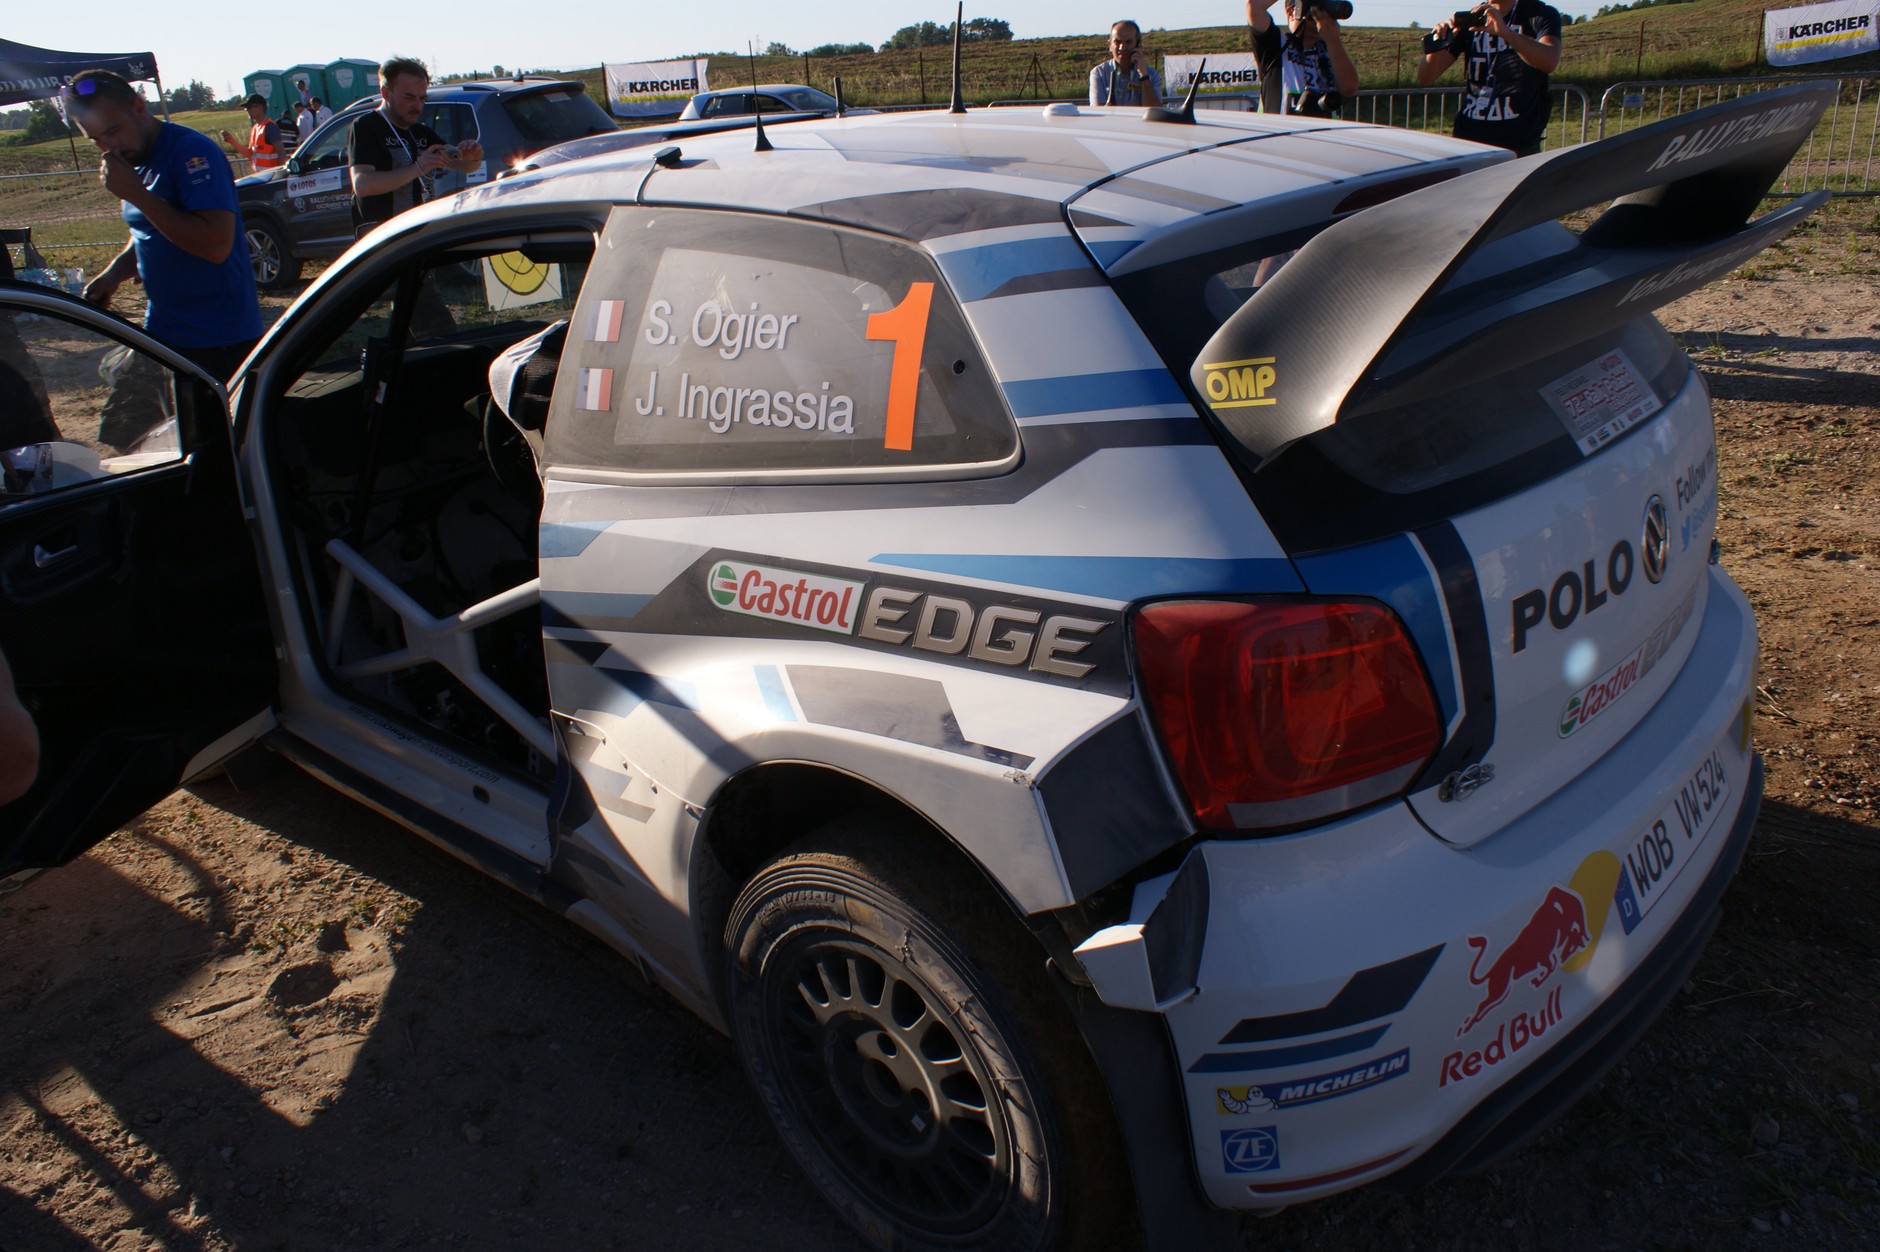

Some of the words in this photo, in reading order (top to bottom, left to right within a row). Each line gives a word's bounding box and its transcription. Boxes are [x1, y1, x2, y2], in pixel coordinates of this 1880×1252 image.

[1788, 14, 1870, 40] KÄRCHER
[628, 78, 699, 93] KÄRCHER
[297, 179, 317, 190] LOTOS
[645, 300, 677, 346] S.
[692, 300, 798, 360] Ogier
[864, 282, 935, 451] 1
[1206, 365, 1276, 401] OMP
[635, 371, 664, 416] J.
[678, 372, 855, 434] Ingrassia
[1676, 459, 1706, 512] Follow
[738, 569, 854, 629] Castrol
[858, 586, 1116, 680] EDGE
[1512, 539, 1634, 655] POLO
[1578, 646, 1643, 725] Castrol
[1627, 819, 1674, 898] WOB
[1674, 780, 1703, 839] VW
[1695, 751, 1726, 812] 524
[1622, 898, 1633, 918] D
[1439, 1023, 1506, 1088] Red
[1510, 984, 1563, 1053] Bull
[1279, 1054, 1409, 1101] MICHELIN
[1229, 1136, 1271, 1164] ZF
